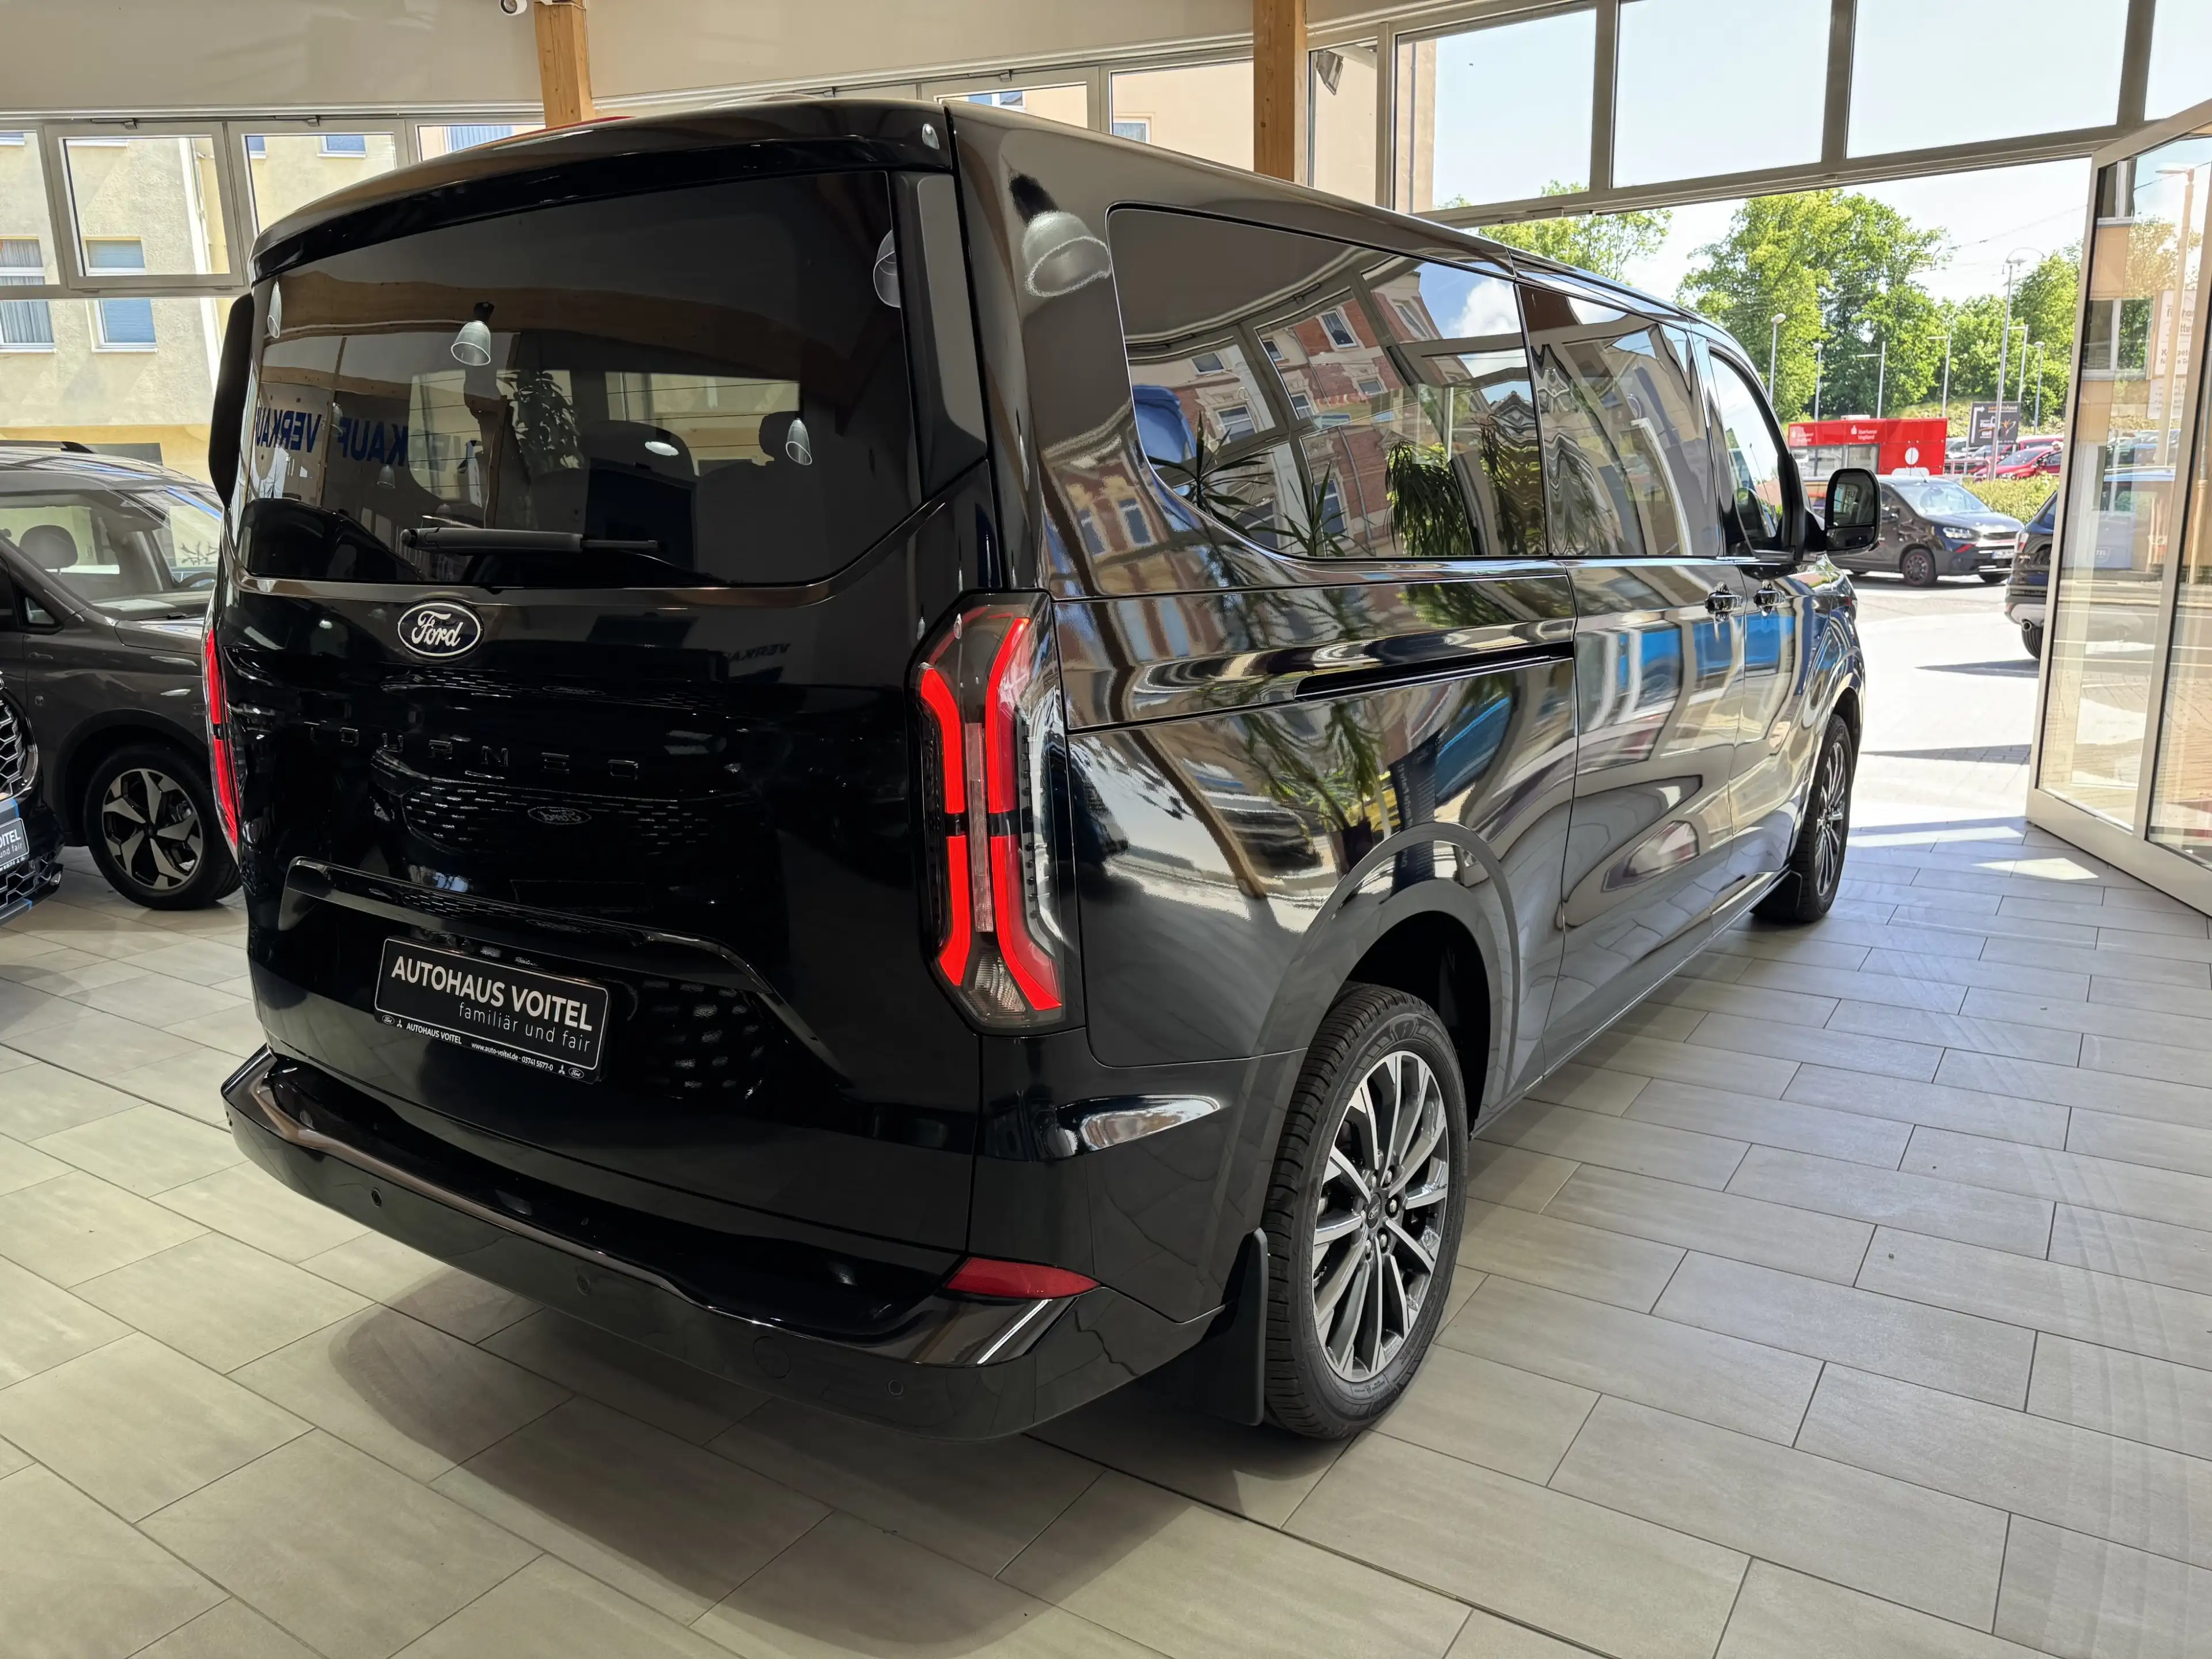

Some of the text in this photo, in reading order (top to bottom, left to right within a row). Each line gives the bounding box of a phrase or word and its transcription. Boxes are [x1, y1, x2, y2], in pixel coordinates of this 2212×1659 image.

[411, 611, 463, 646] Ford
[391, 956, 592, 1032] AUTOHAUS VOITEL
[406, 1022, 462, 1044] AUTOHAUS VOITEL
[459, 1002, 590, 1052] familiär und fair
[471, 1043, 518, 1060] www.auto-voitel.de
[521, 1056, 536, 1066] 03741
